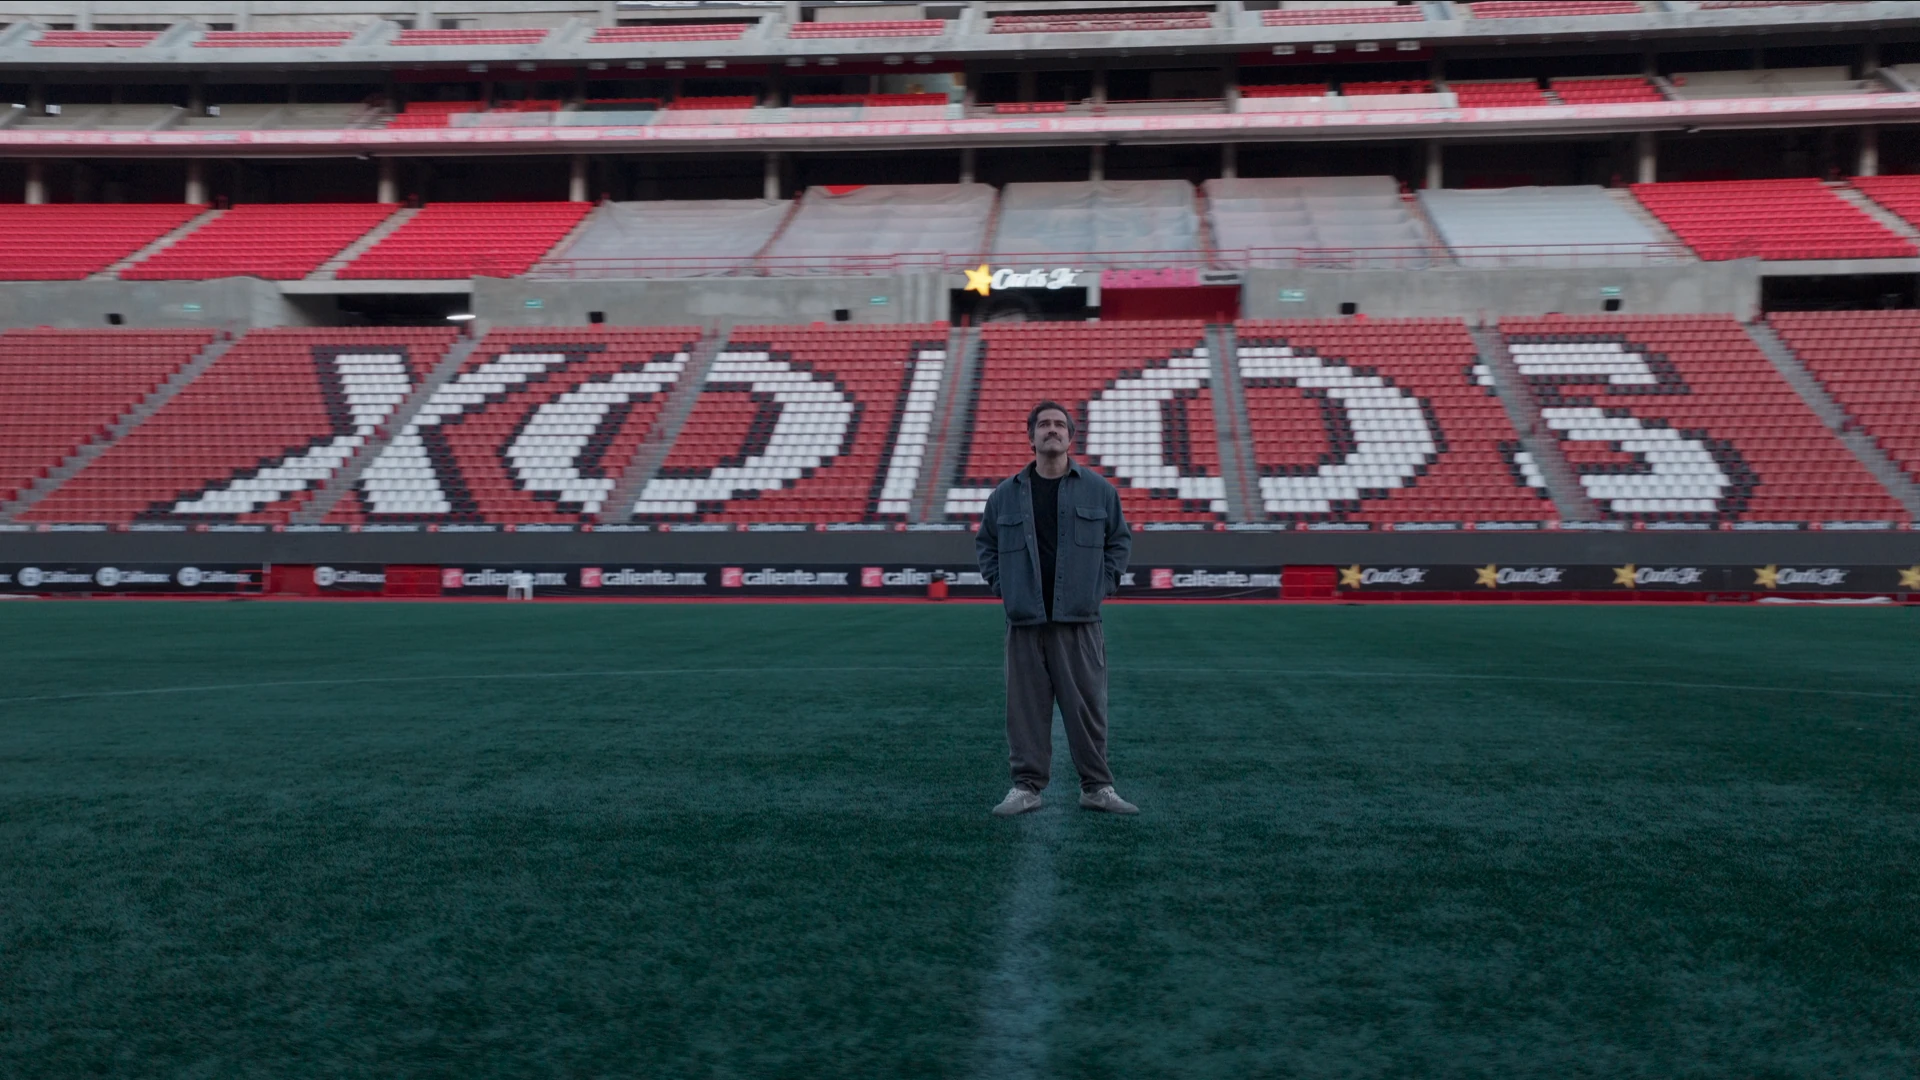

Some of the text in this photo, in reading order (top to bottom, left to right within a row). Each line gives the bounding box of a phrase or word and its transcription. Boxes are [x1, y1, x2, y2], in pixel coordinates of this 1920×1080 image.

[168, 343, 1738, 517] XOLOS
[601, 568, 707, 585] caliente.mx
[742, 568, 848, 585] caliente.mx
[1173, 569, 1282, 587] caliente.mx
